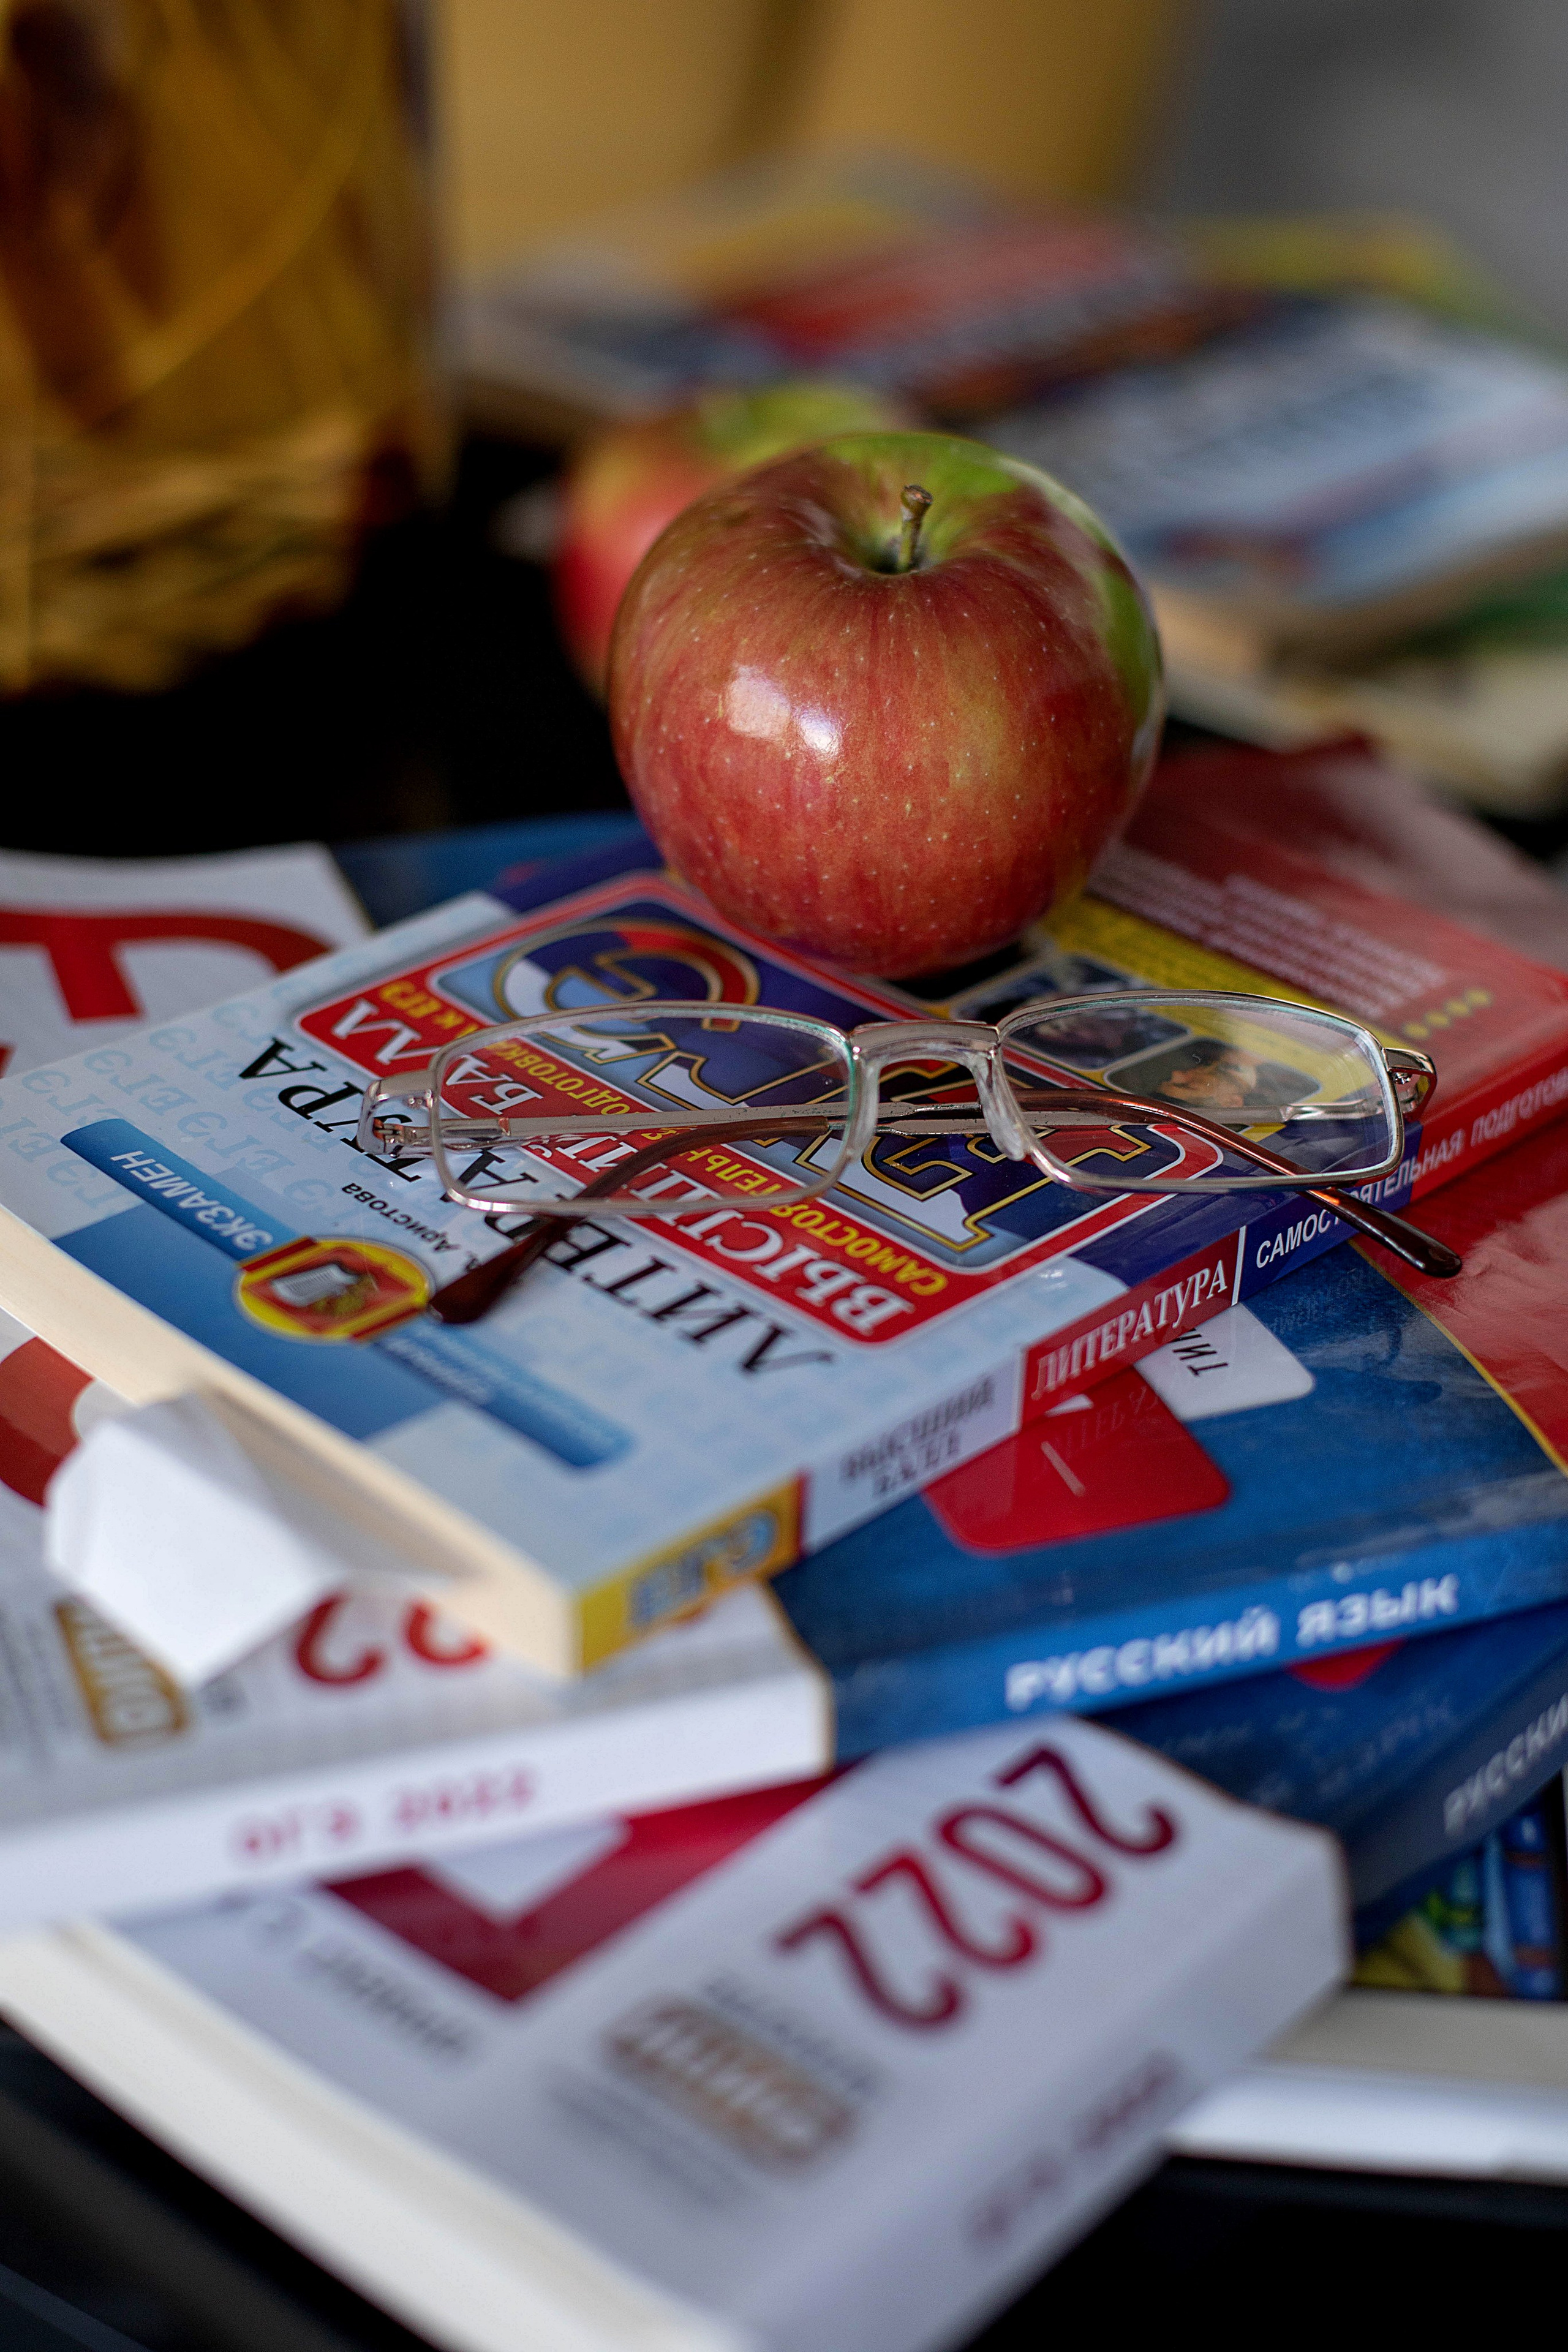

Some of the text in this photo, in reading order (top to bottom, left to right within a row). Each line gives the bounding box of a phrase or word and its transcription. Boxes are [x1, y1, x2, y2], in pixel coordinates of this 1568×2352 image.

[331, 998, 544, 1115] БАЛЛ
[110, 1150, 273, 1252] ЭКЗАМЕН
[341, 1182, 461, 1252] Аристова
[1031, 1259, 1229, 1400] ЛИТЕРАТУРА
[1005, 1572, 1460, 1709] РУССКИЙ ЯЗЫК
[773, 1741, 1180, 2032] 2022
